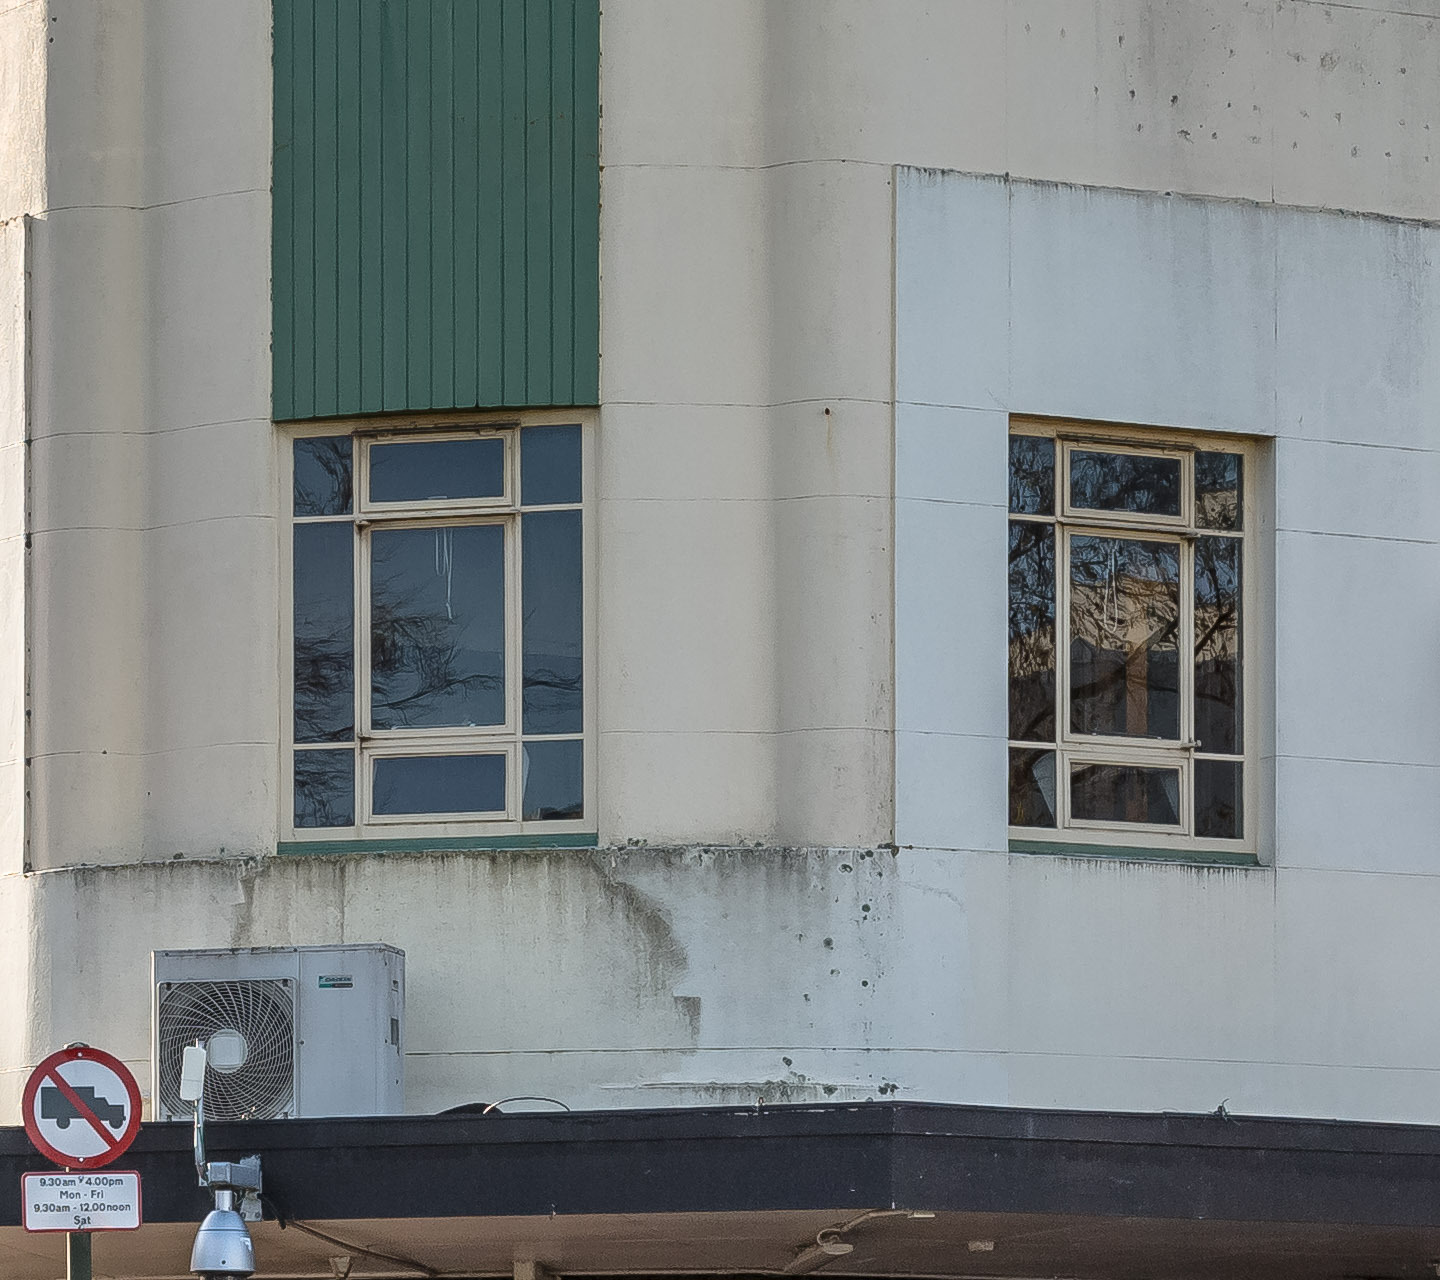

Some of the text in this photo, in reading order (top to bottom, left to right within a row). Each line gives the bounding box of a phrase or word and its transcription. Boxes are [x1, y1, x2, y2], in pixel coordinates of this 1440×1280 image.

[39, 1176, 124, 1188] 9.30am 4.00pm
[59, 1190, 82, 1200] Mon
[90, 1189, 104, 1199] Fri
[33, 1203, 71, 1213] 9.30am
[73, 1214, 92, 1225] Sat
